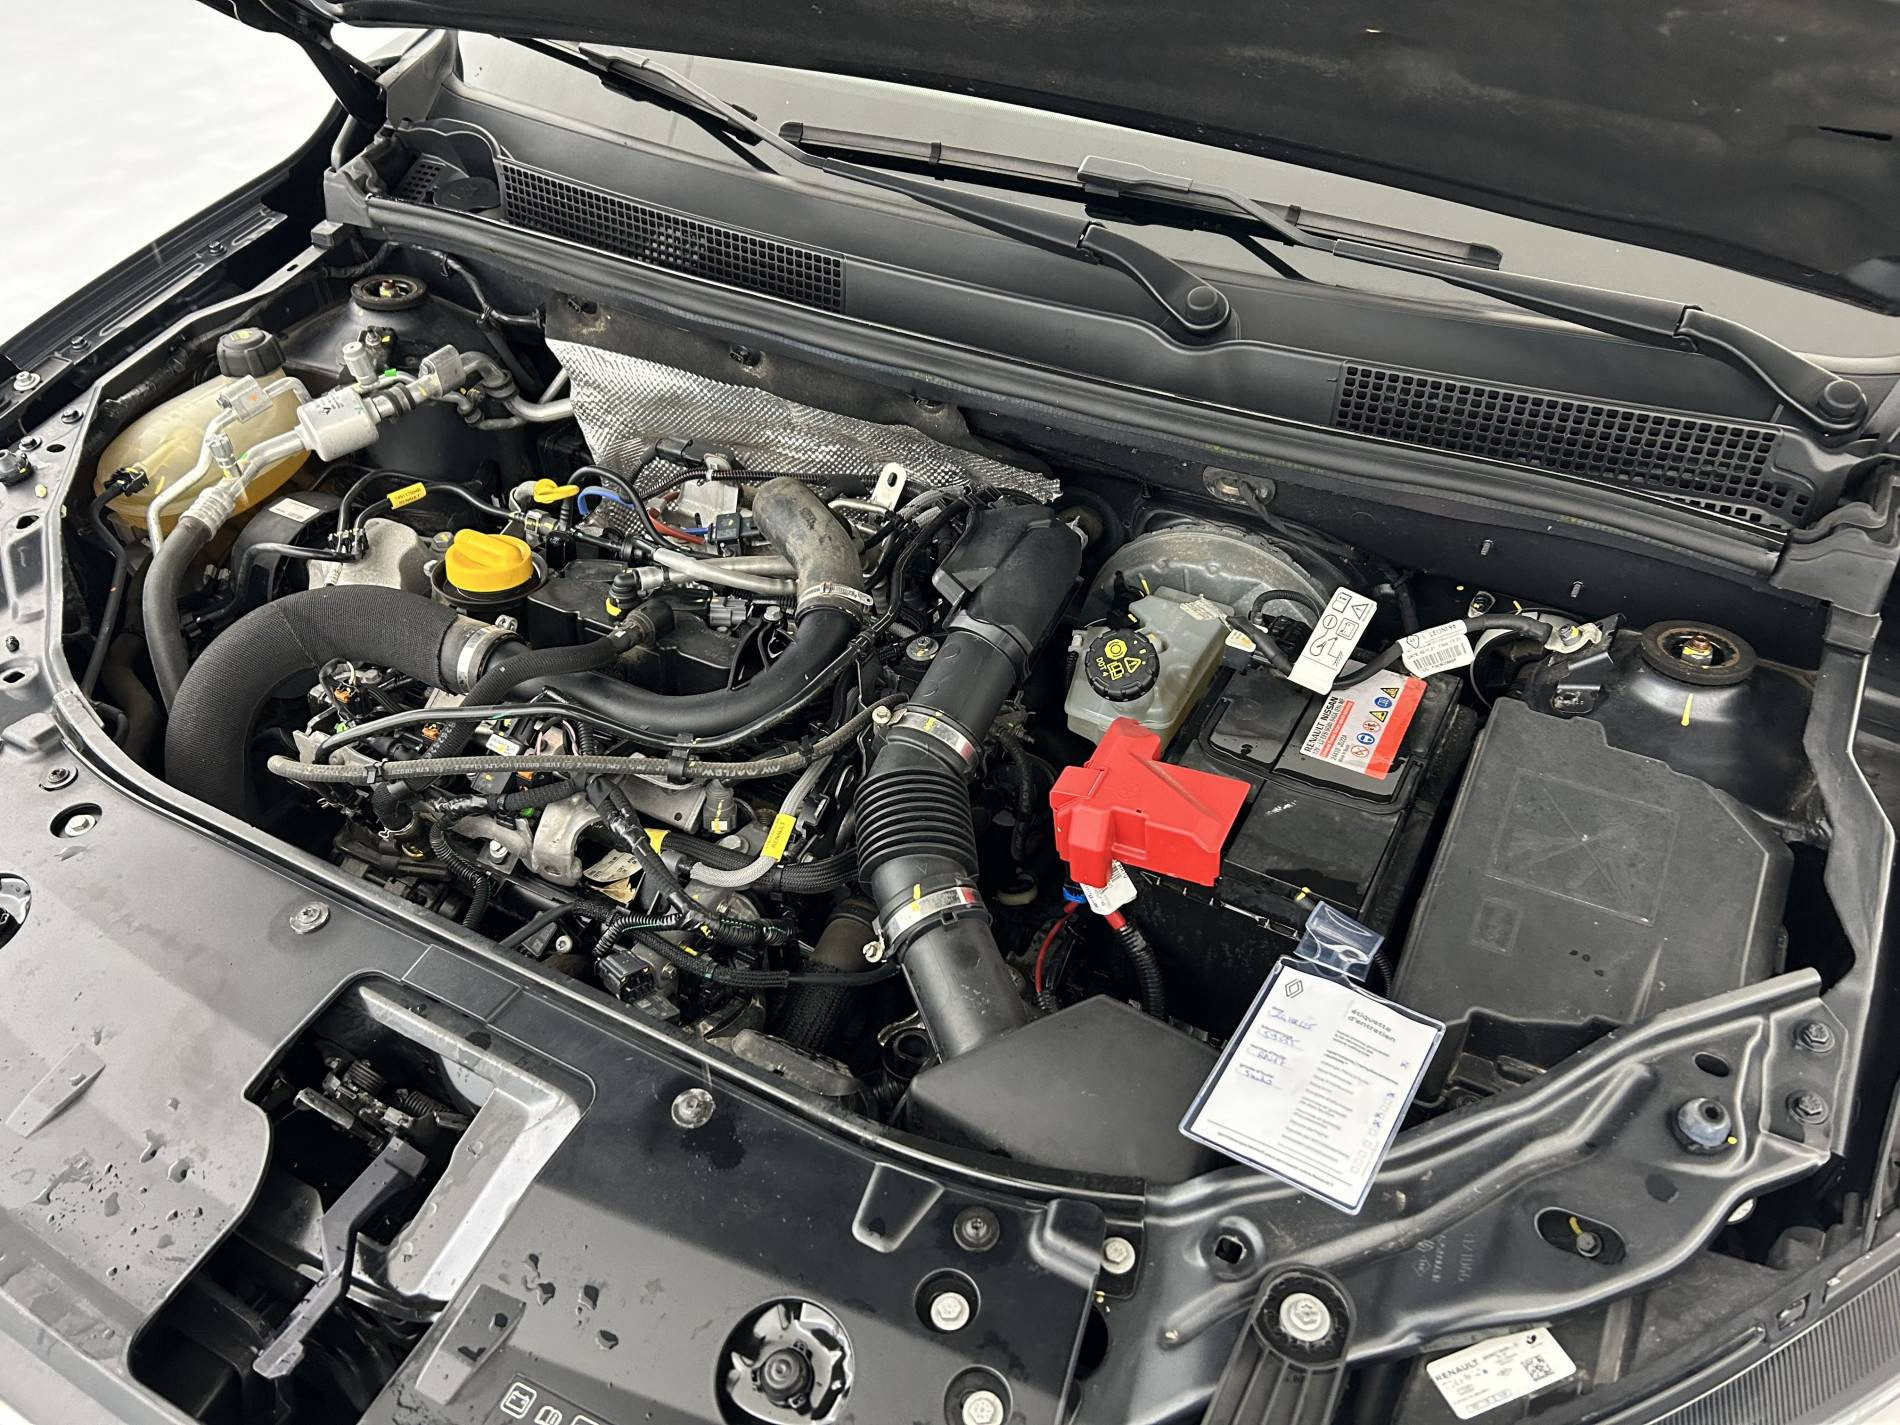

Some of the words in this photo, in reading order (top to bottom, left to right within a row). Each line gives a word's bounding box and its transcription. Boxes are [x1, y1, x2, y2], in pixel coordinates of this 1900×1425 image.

[1096, 656, 1107, 670] DOT
[1304, 722, 1325, 752] RENAULT
[1320, 696, 1338, 721] NISSAN
[1435, 1358, 1480, 1381] RENAULT
